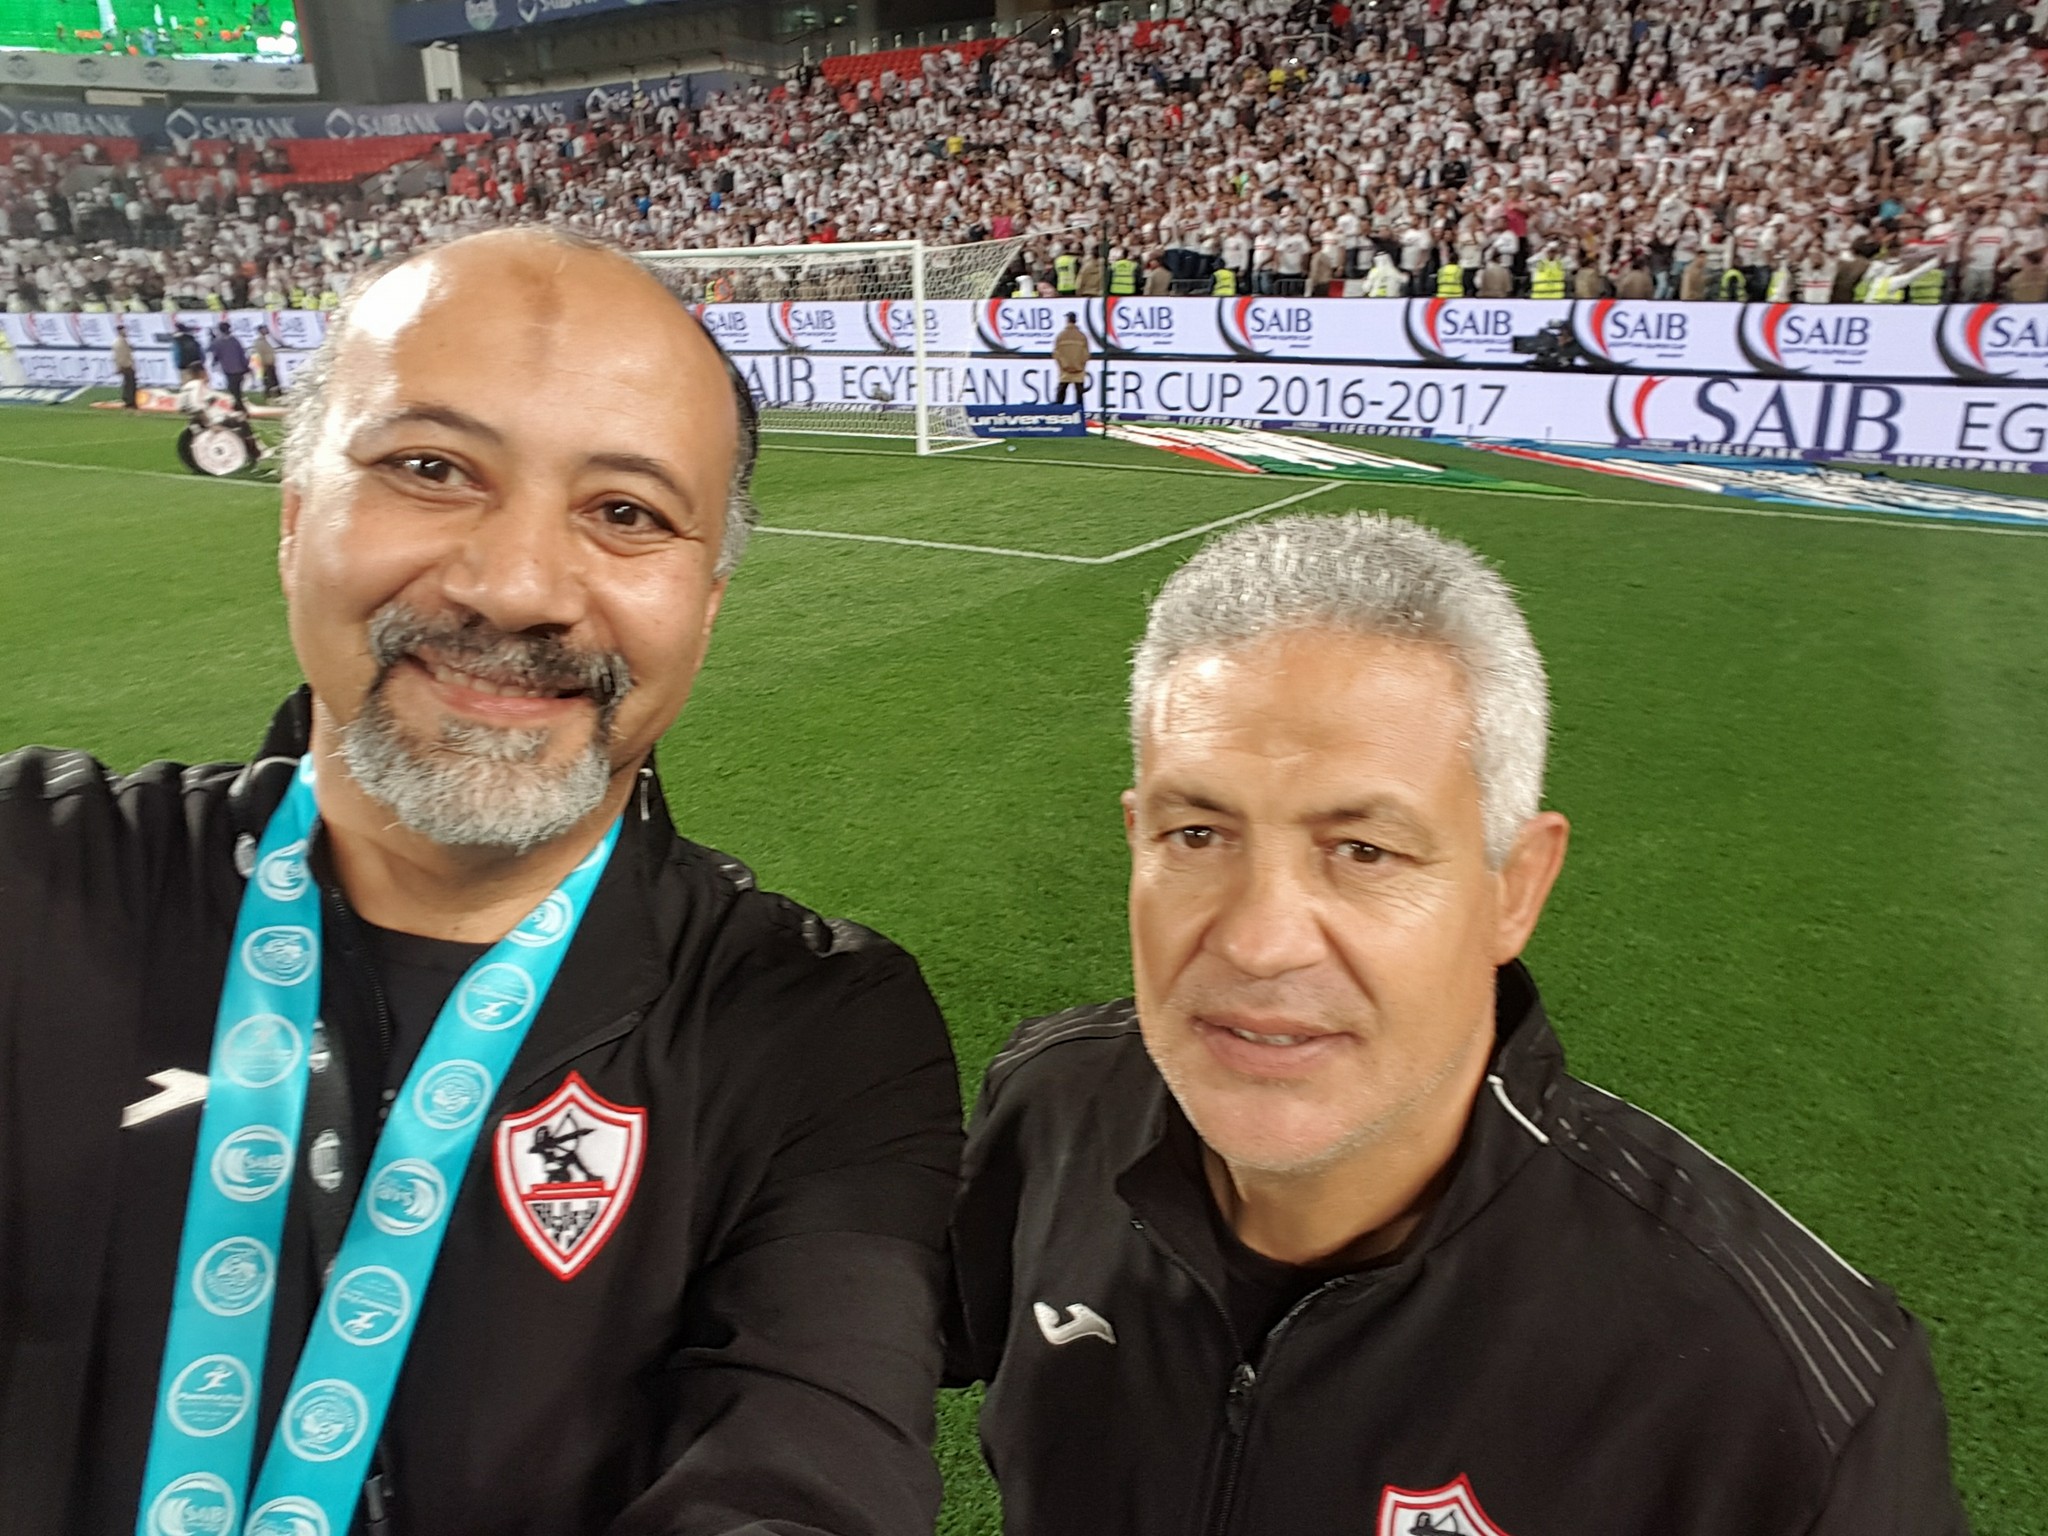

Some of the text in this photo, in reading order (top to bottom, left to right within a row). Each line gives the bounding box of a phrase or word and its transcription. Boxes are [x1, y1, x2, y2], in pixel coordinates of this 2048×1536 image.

[704, 310, 747, 332] SAIB
[791, 309, 836, 330] SAIB
[890, 309, 938, 330] SAB
[1001, 307, 1053, 330] SAIB
[1117, 306, 1173, 331] SAIB
[1251, 307, 1312, 333] SAIB
[1442, 309, 1512, 336] SAIB
[1610, 311, 1688, 340] SAIB
[1783, 315, 1870, 346] SAIB
[1989, 316, 2048, 347] SA
[745, 356, 816, 405] AIB
[1156, 371, 1242, 413] CUP
[1258, 376, 1506, 426] 2016-2017
[969, 412, 1081, 426] universal
[1693, 378, 1904, 453] SAIB
